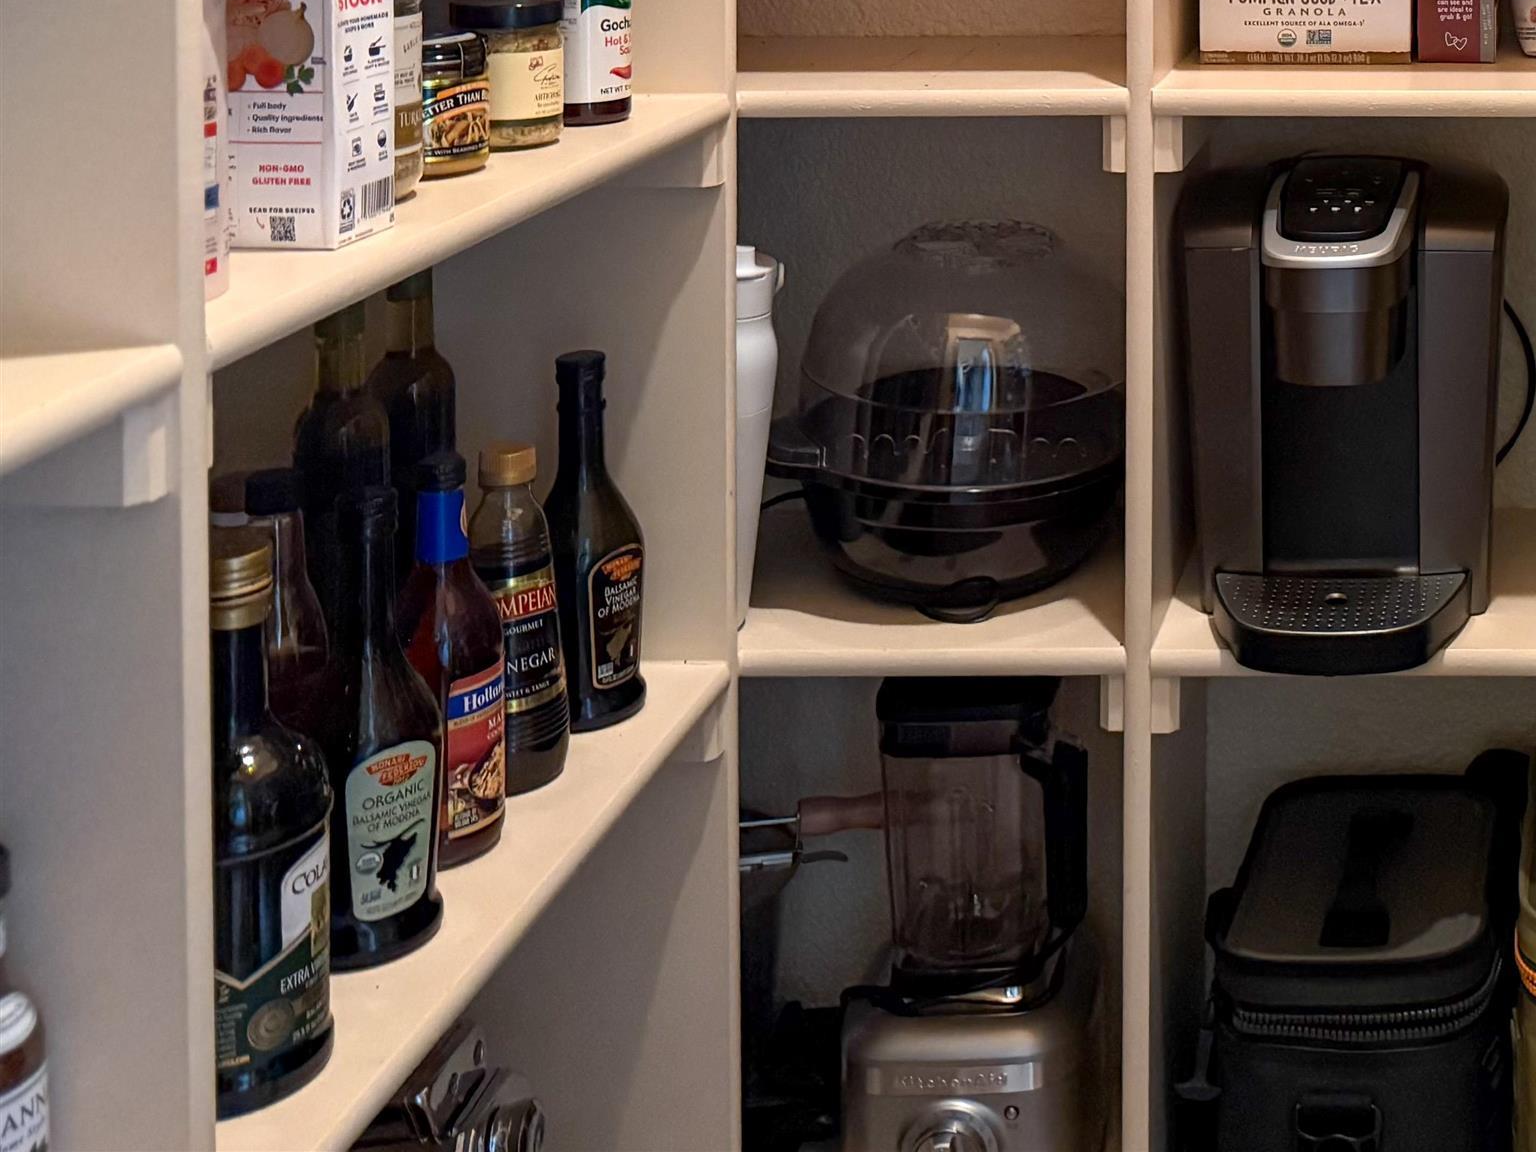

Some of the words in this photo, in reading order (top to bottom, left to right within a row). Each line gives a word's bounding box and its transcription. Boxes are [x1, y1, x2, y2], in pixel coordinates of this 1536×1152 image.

[1263, 8, 1346, 16] GRANOLA
[1440, 13, 1454, 21] grab
[605, 35, 622, 47] Hot
[457, 91, 480, 105] THAN
[252, 102, 267, 110] Full
[267, 102, 287, 112] body
[252, 114, 279, 123] Quality
[280, 114, 324, 123] ingredients
[259, 164, 305, 173] NON-GMO
[252, 177, 287, 186] GLUTEN
[288, 177, 311, 186] FREE
[604, 576, 638, 597] BALSAMIC
[605, 586, 636, 606] VINEGAR
[598, 606, 609, 618] OF
[362, 779, 425, 810] ORGANIC
[352, 806, 398, 826] BALSAMIC
[399, 791, 431, 813] VINEGAR
[367, 821, 381, 833] OF
[383, 810, 421, 829] MODENA
[280, 967, 310, 995] EXTRA
